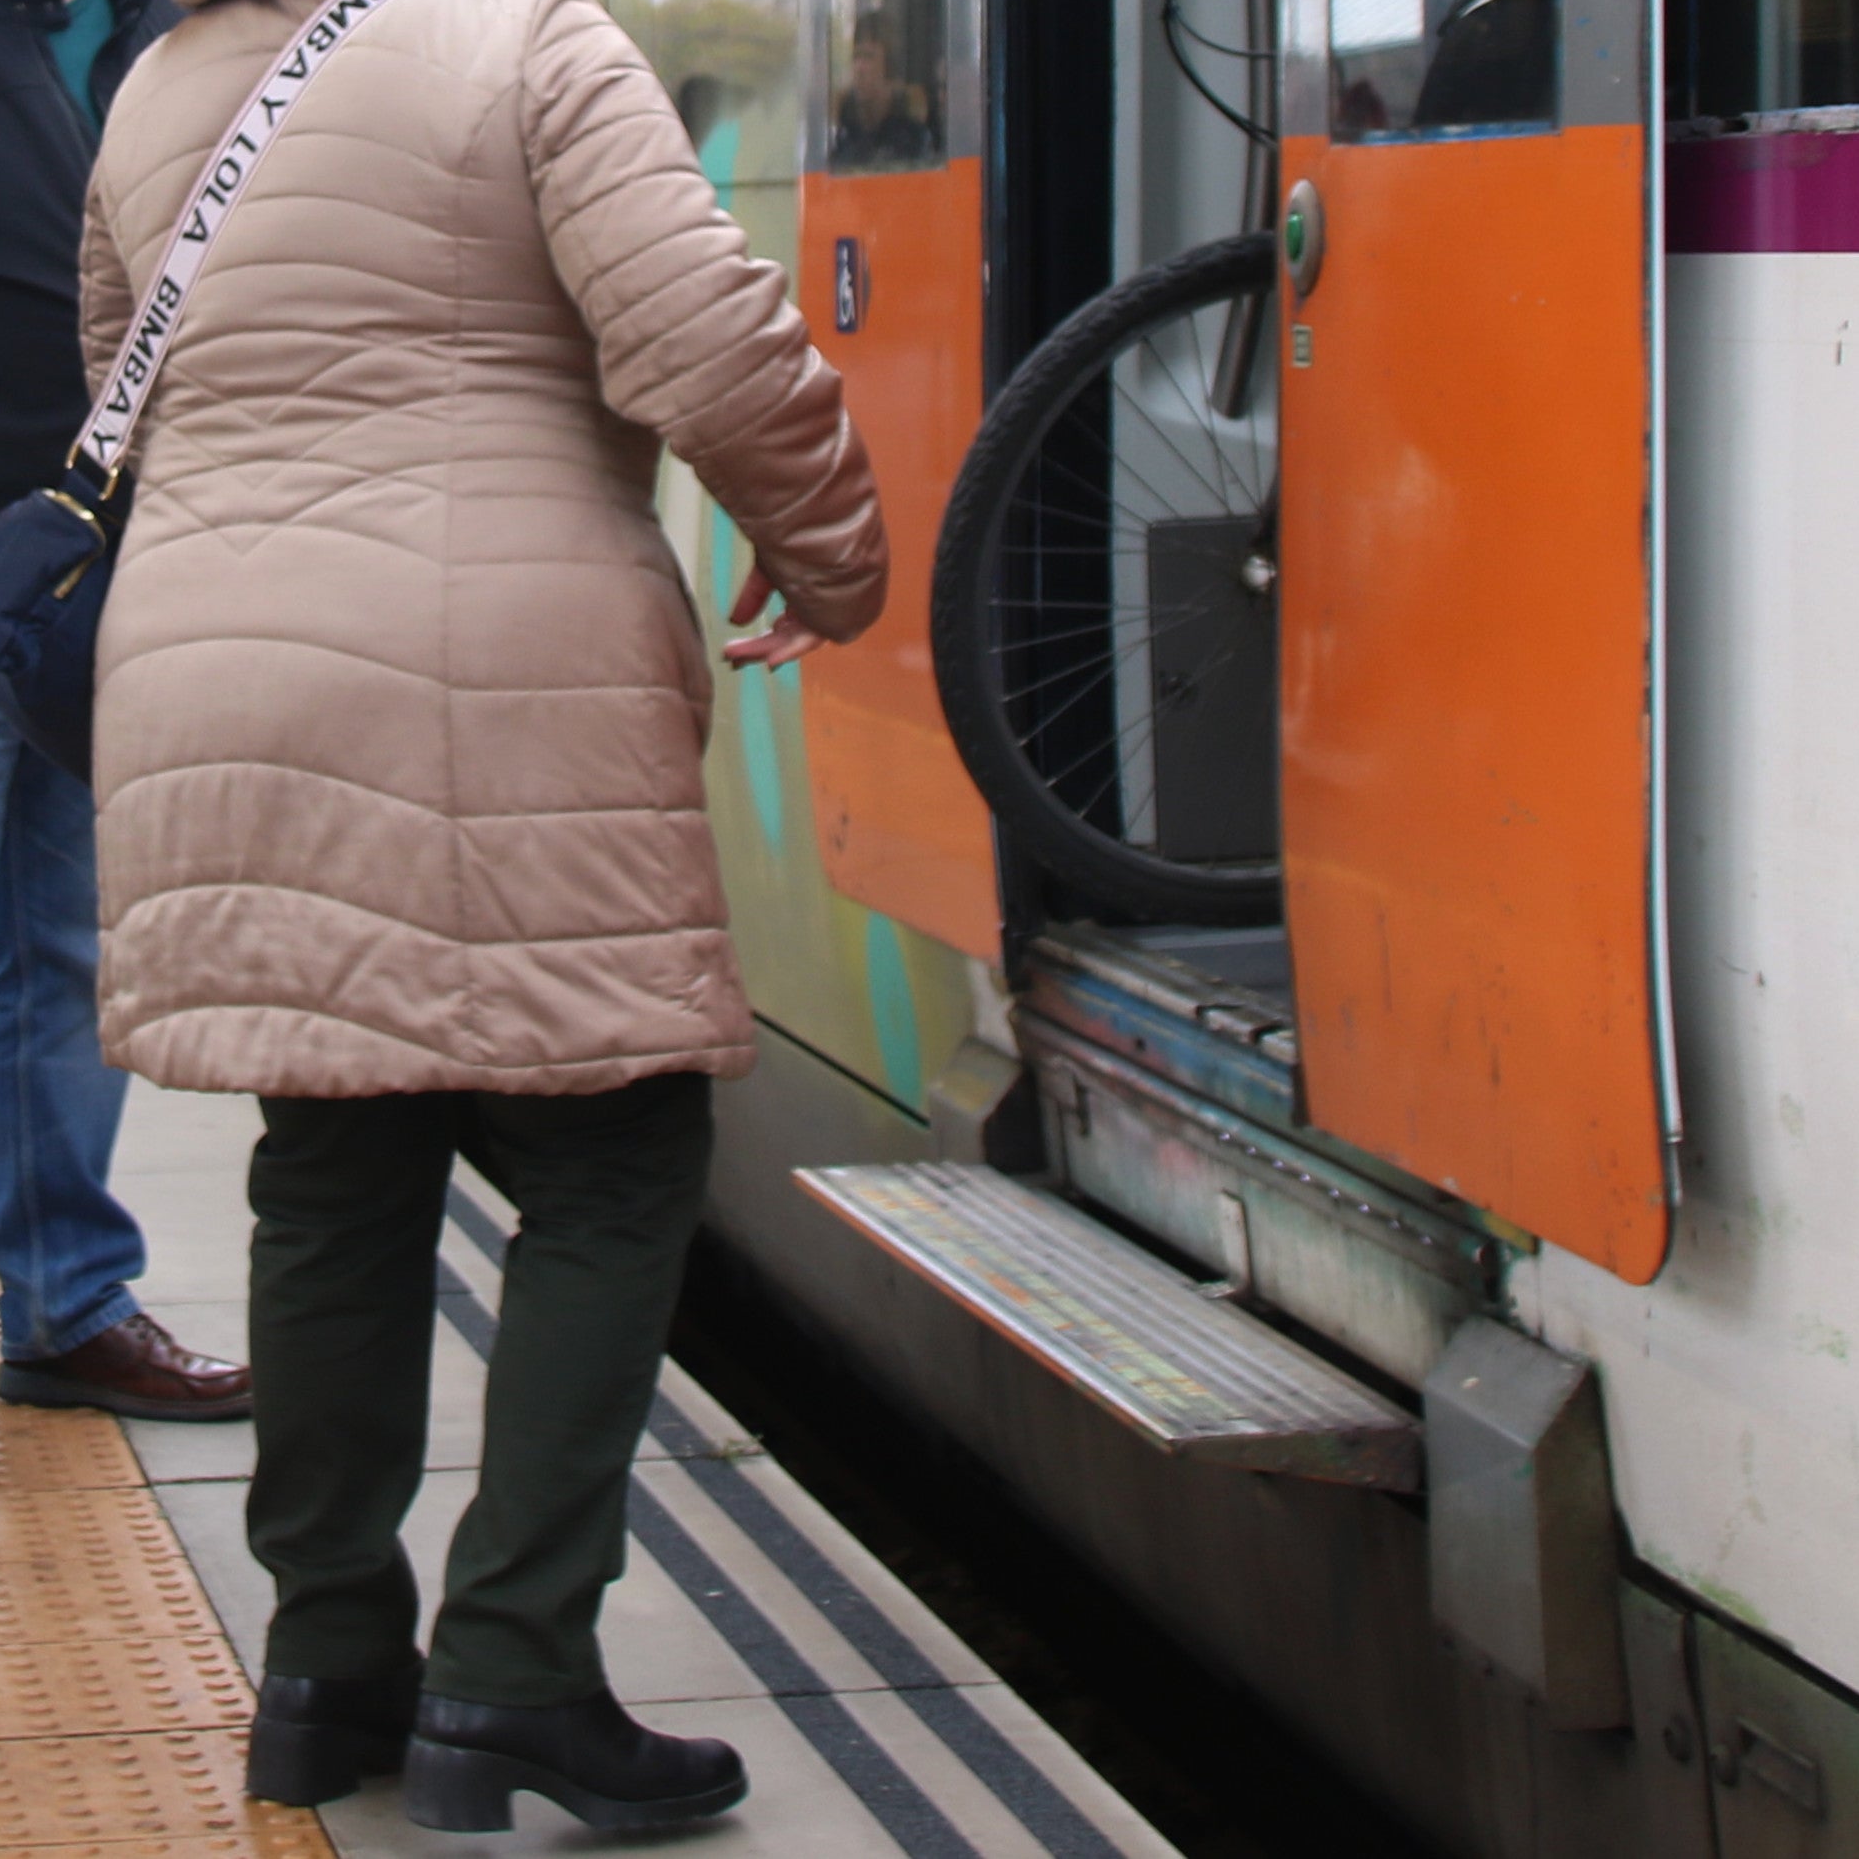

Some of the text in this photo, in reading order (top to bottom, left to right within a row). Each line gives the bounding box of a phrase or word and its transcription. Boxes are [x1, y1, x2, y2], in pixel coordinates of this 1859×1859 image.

[260, 96, 288, 127] Y
[182, 131, 259, 243] LOLA
[105, 276, 182, 414] BIMBA
[92, 430, 118, 461] Y
